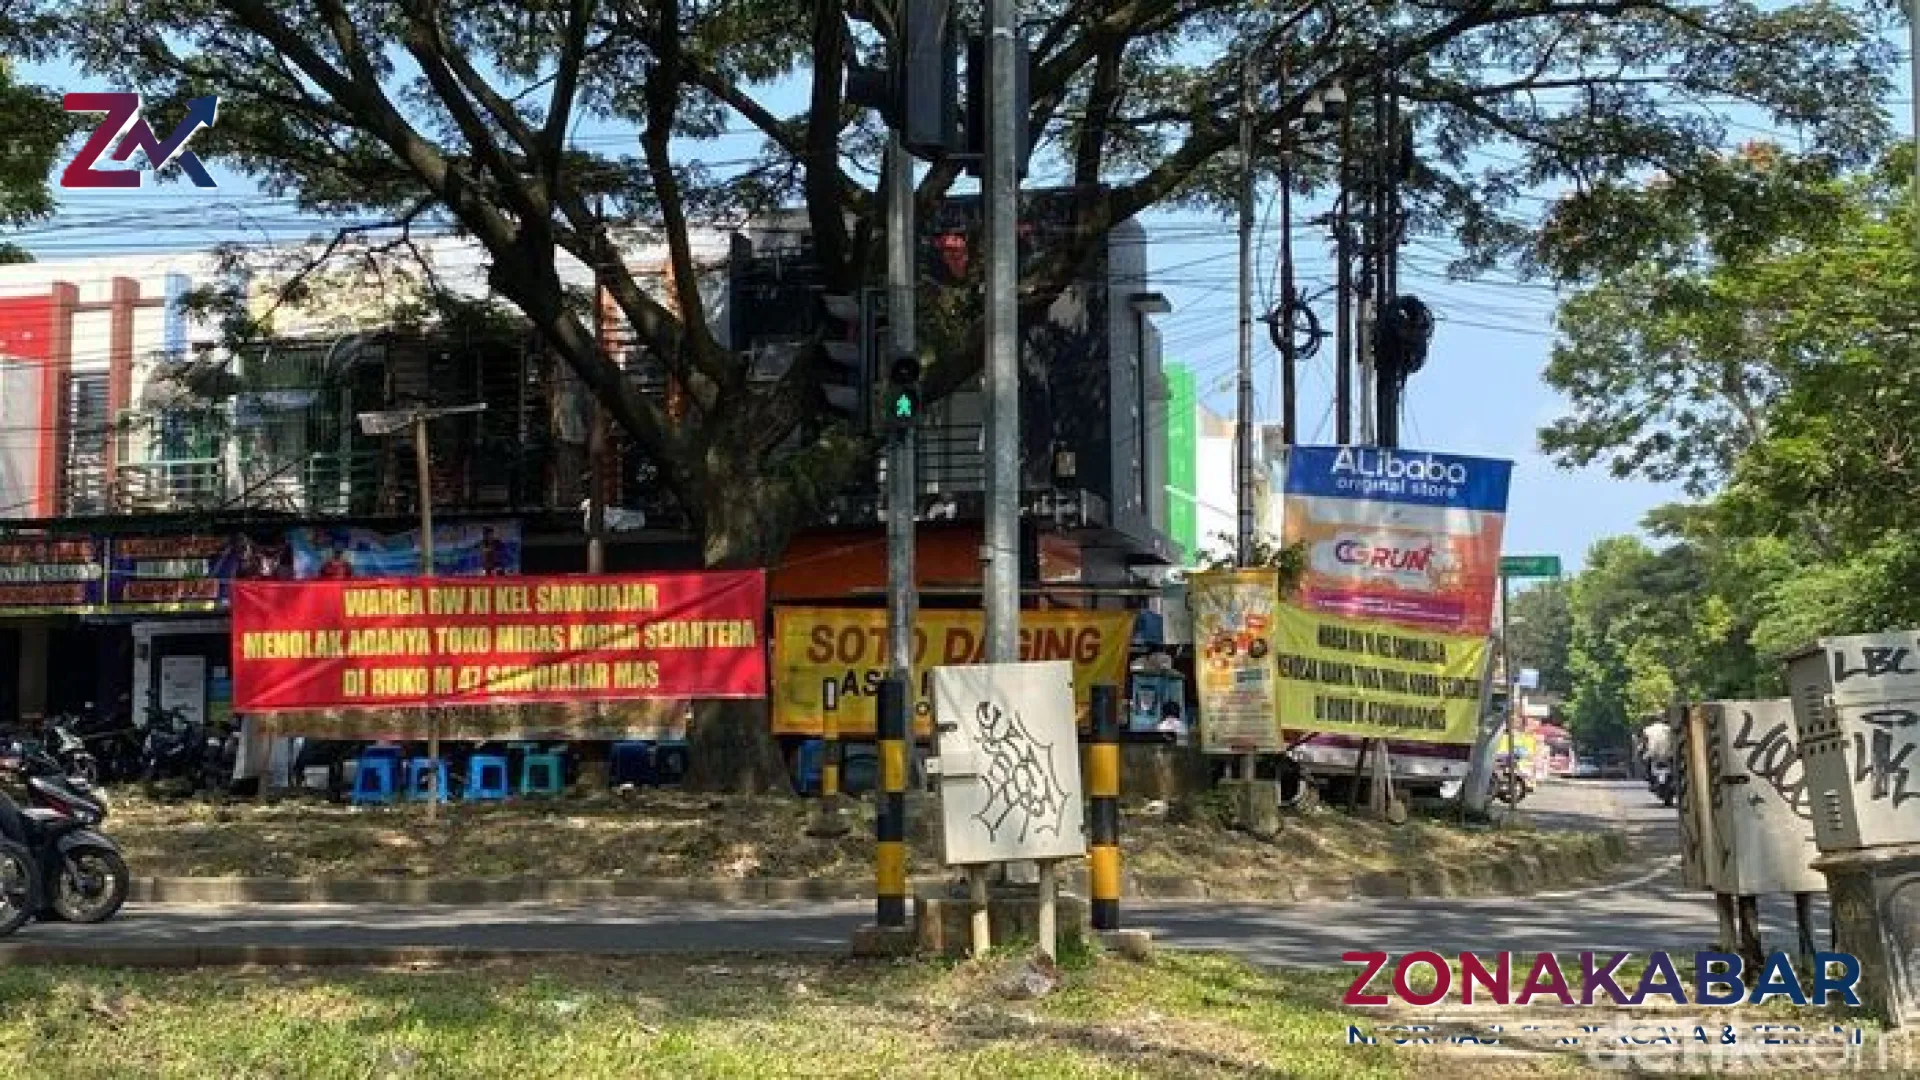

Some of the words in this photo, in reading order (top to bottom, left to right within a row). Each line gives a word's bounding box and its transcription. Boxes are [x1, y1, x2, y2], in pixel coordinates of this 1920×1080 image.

[1336, 476, 1405, 496] original
[1410, 482, 1458, 498] store
[345, 587, 425, 617] WARGA
[428, 586, 465, 615] RW
[495, 586, 532, 614] KEL
[535, 583, 659, 613] SAWOJAJAR
[243, 629, 344, 659] MENOLAK
[347, 626, 432, 656] ADANYA
[435, 624, 493, 654] TOKO
[496, 623, 567, 653] MIRAS
[643, 619, 756, 648] SEJAHTERA
[343, 667, 366, 697] DI
[370, 665, 429, 695] RUKO
[433, 665, 453, 695] M
[485, 661, 610, 693] SAWOJAJAR
[613, 659, 660, 689] MAS
